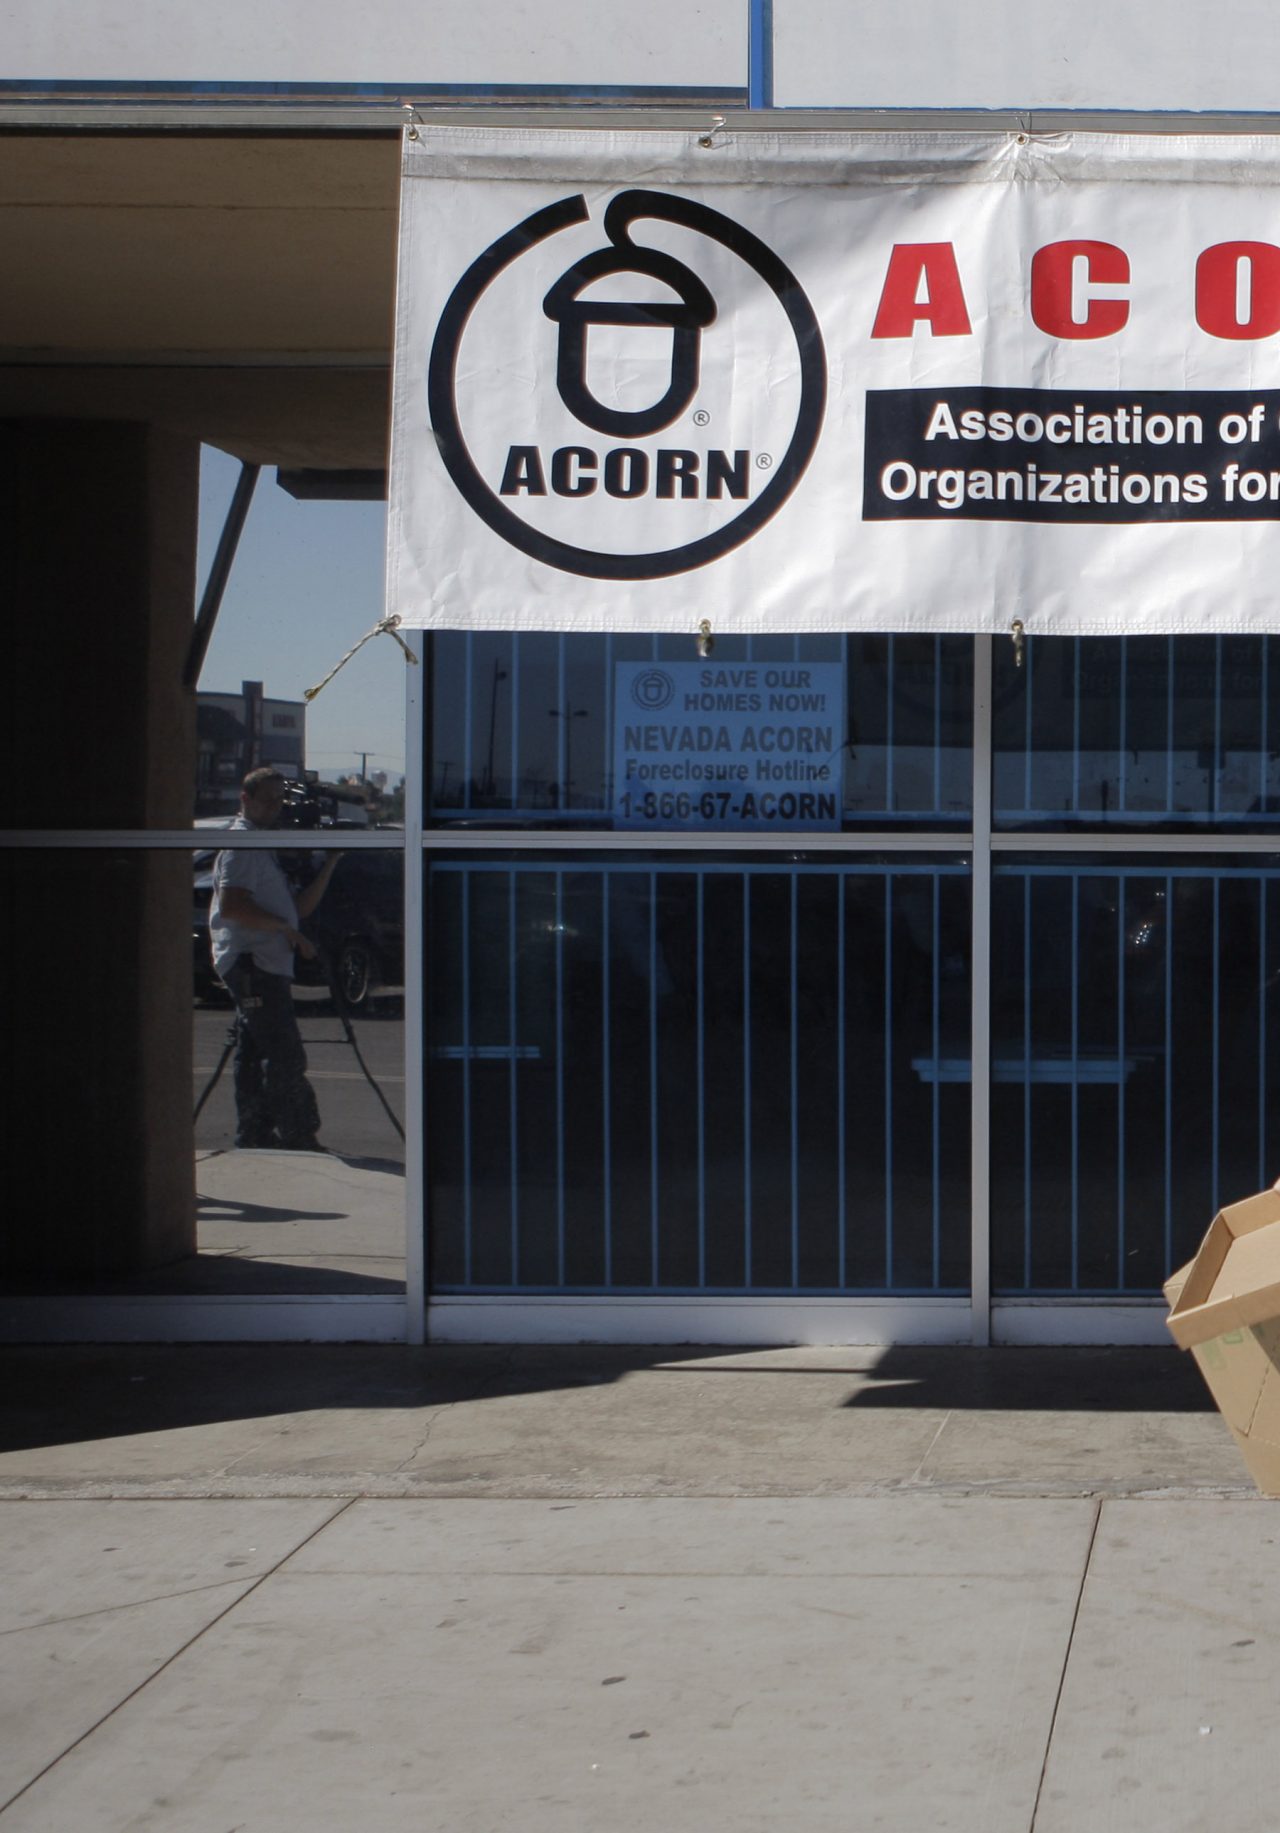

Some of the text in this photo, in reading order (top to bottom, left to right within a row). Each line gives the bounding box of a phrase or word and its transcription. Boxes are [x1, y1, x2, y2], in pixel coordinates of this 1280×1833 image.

[925, 403, 1203, 446] Association
[1218, 405, 1265, 445] of
[880, 460, 1208, 508] Organizations
[700, 670, 811, 688] SAVE OUR
[683, 694, 826, 712] HOMES NOW!
[624, 726, 832, 753] NEVADA ACORN
[625, 758, 831, 781] Foreclosure Hotline
[620, 791, 836, 820] 1-866-67-ACORN
